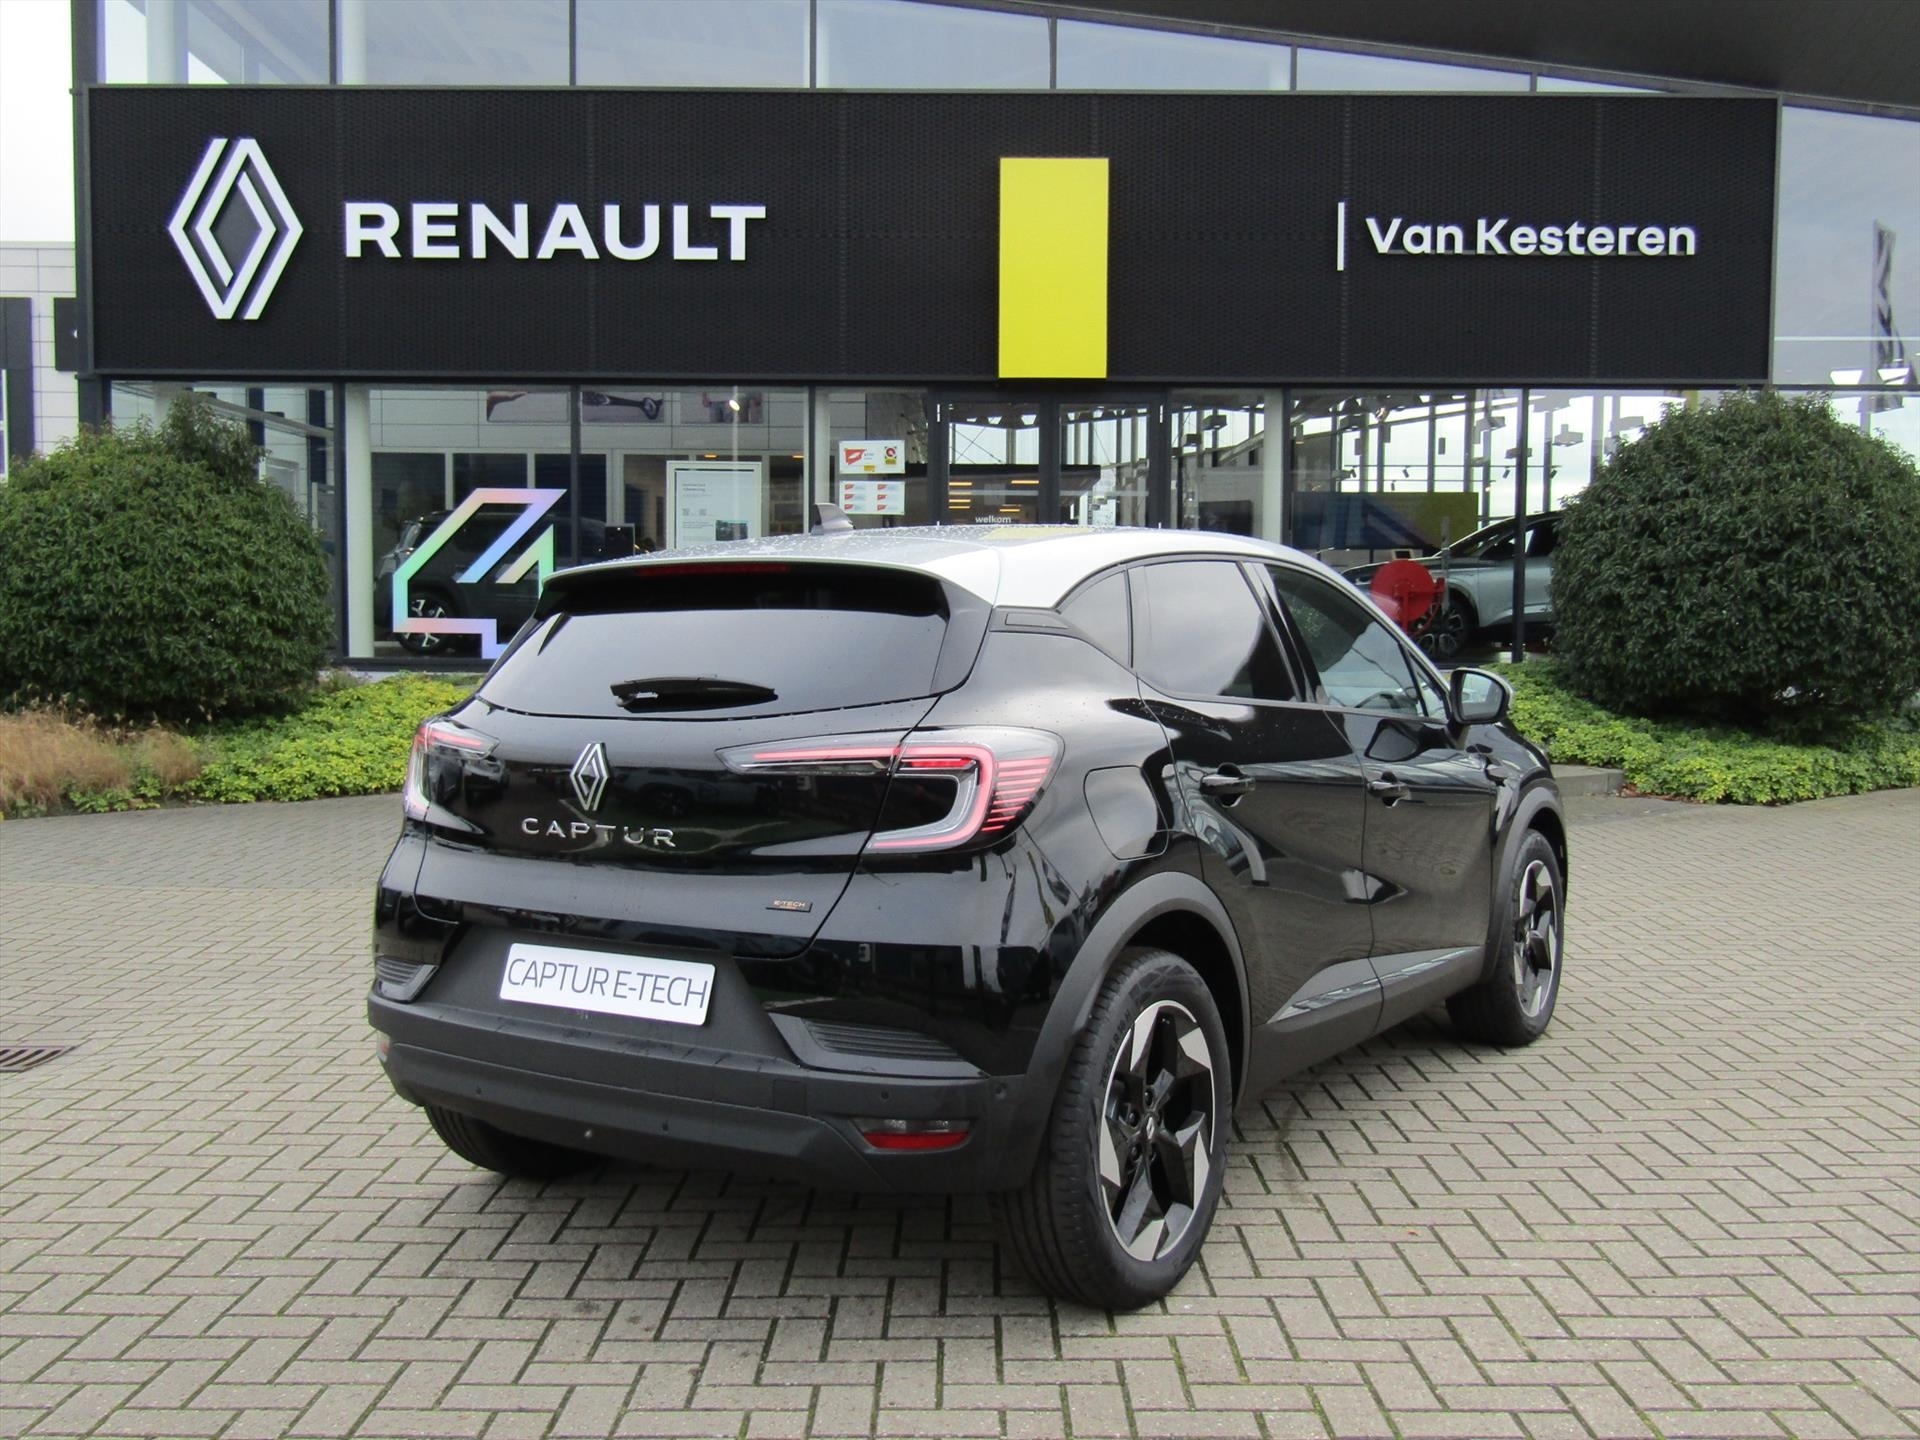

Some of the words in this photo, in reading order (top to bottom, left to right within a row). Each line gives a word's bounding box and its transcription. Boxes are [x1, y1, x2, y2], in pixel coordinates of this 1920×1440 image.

[345, 202, 766, 261] RENAULT
[1365, 217, 1464, 255] Van
[1476, 218, 1696, 256] Kesteren
[975, 515, 1011, 524] welkom
[521, 817, 676, 848] CAPTUR
[507, 958, 610, 997] CAPTUR
[612, 970, 708, 1009] E-TECH
